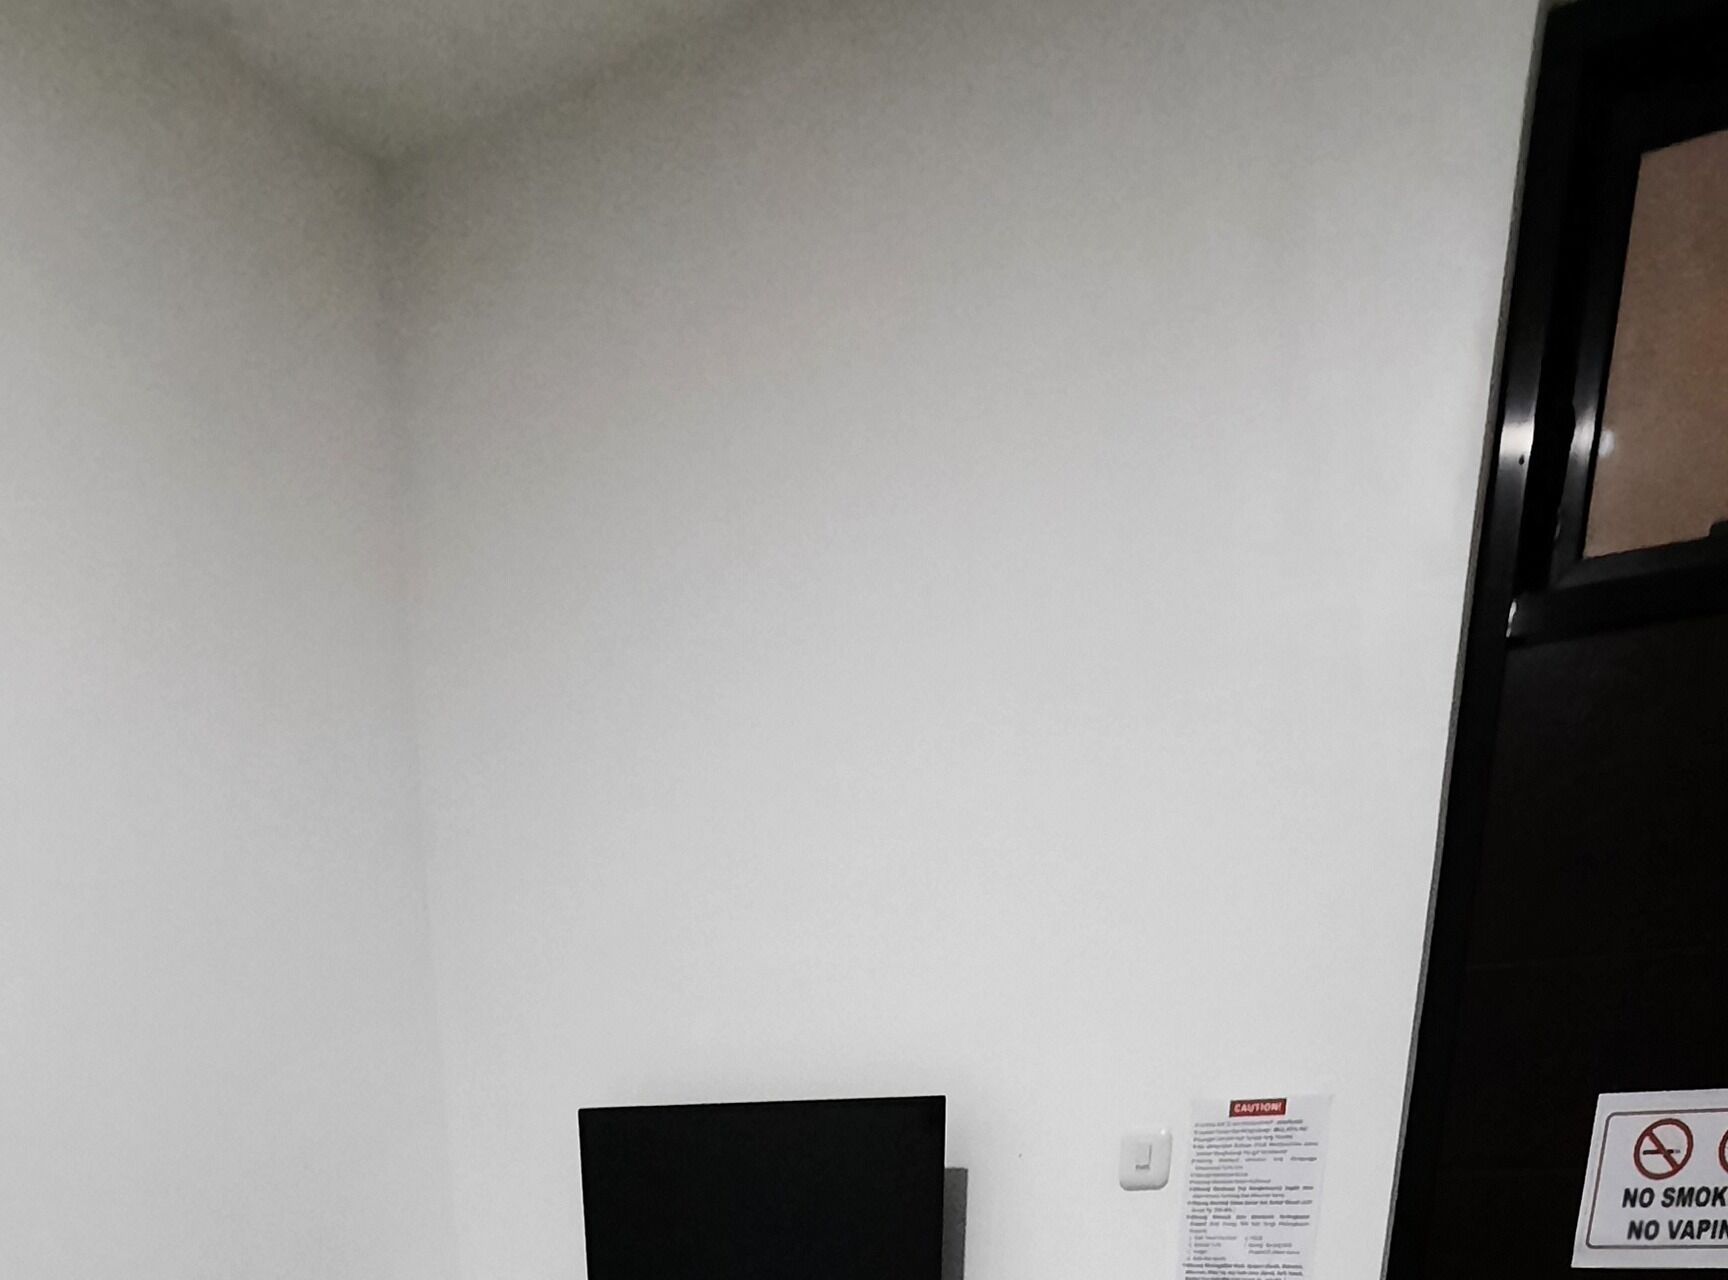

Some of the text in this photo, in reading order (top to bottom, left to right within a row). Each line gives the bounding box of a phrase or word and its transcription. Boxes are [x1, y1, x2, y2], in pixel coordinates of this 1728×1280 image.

[1233, 1102, 1283, 1113] CAUTION!
[1622, 1187, 1655, 1208] NO
[1627, 1220, 1660, 1240] NO
